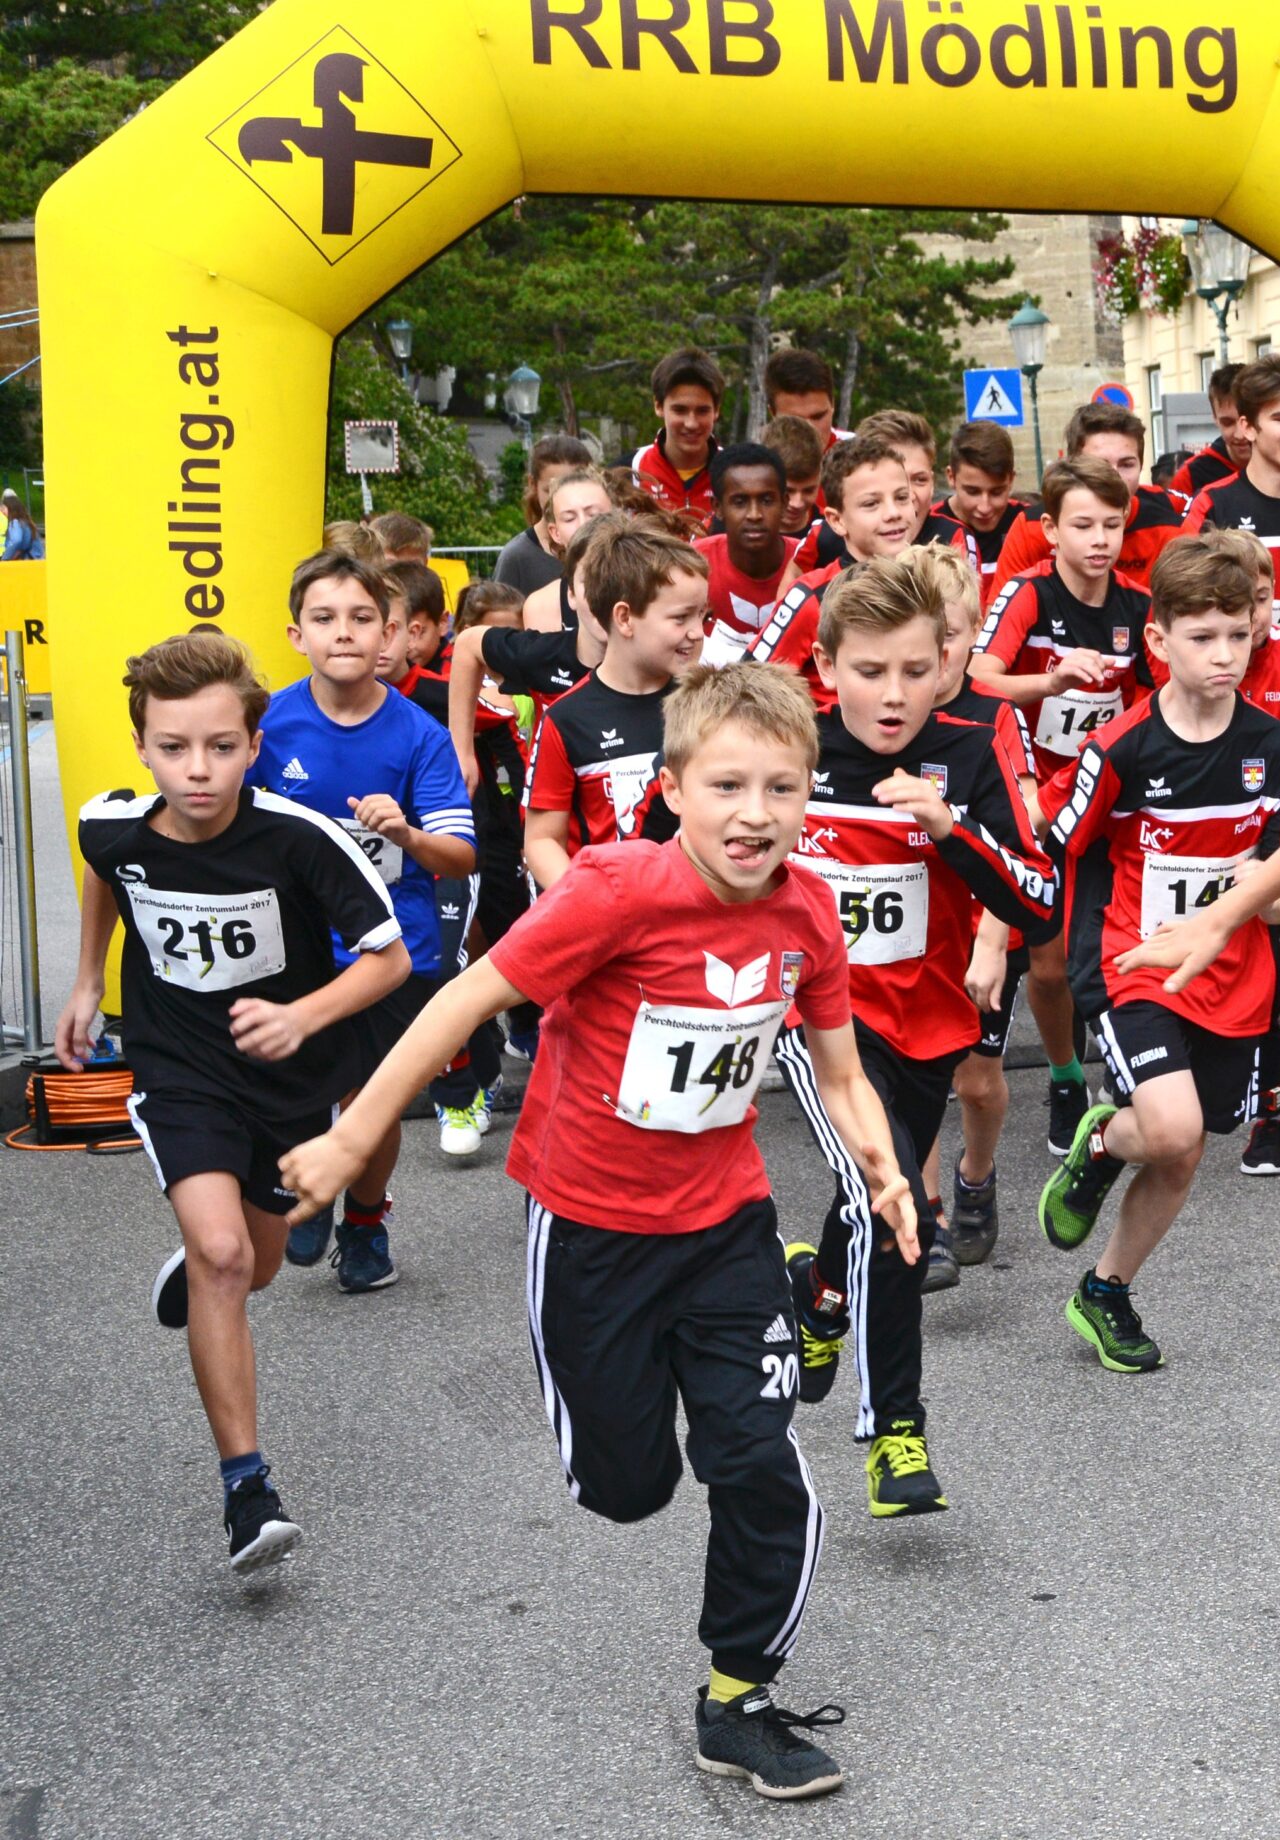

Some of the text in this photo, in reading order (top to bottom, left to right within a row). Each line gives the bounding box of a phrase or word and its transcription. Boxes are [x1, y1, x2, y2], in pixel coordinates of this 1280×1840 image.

[530, 0, 1238, 114] RRB Mödling
[550, 675, 574, 687] erima
[600, 737, 625, 749] erima
[1145, 787, 1172, 798] erima
[1234, 815, 1262, 835] FLORIAN
[1149, 863, 1206, 873] Perchtoldsdorfer
[852, 874, 903, 883] Zentrumslauf
[905, 873, 923, 882] 2017
[195, 904, 249, 913] Zentrumslauf
[250, 899, 271, 910] 2017
[157, 916, 257, 962] 216
[644, 1014, 723, 1033] Perchtoldsdorfer
[666, 1036, 760, 1094] 148
[1130, 1046, 1168, 1070] FLORIAN
[760, 1353, 799, 1399] 20
